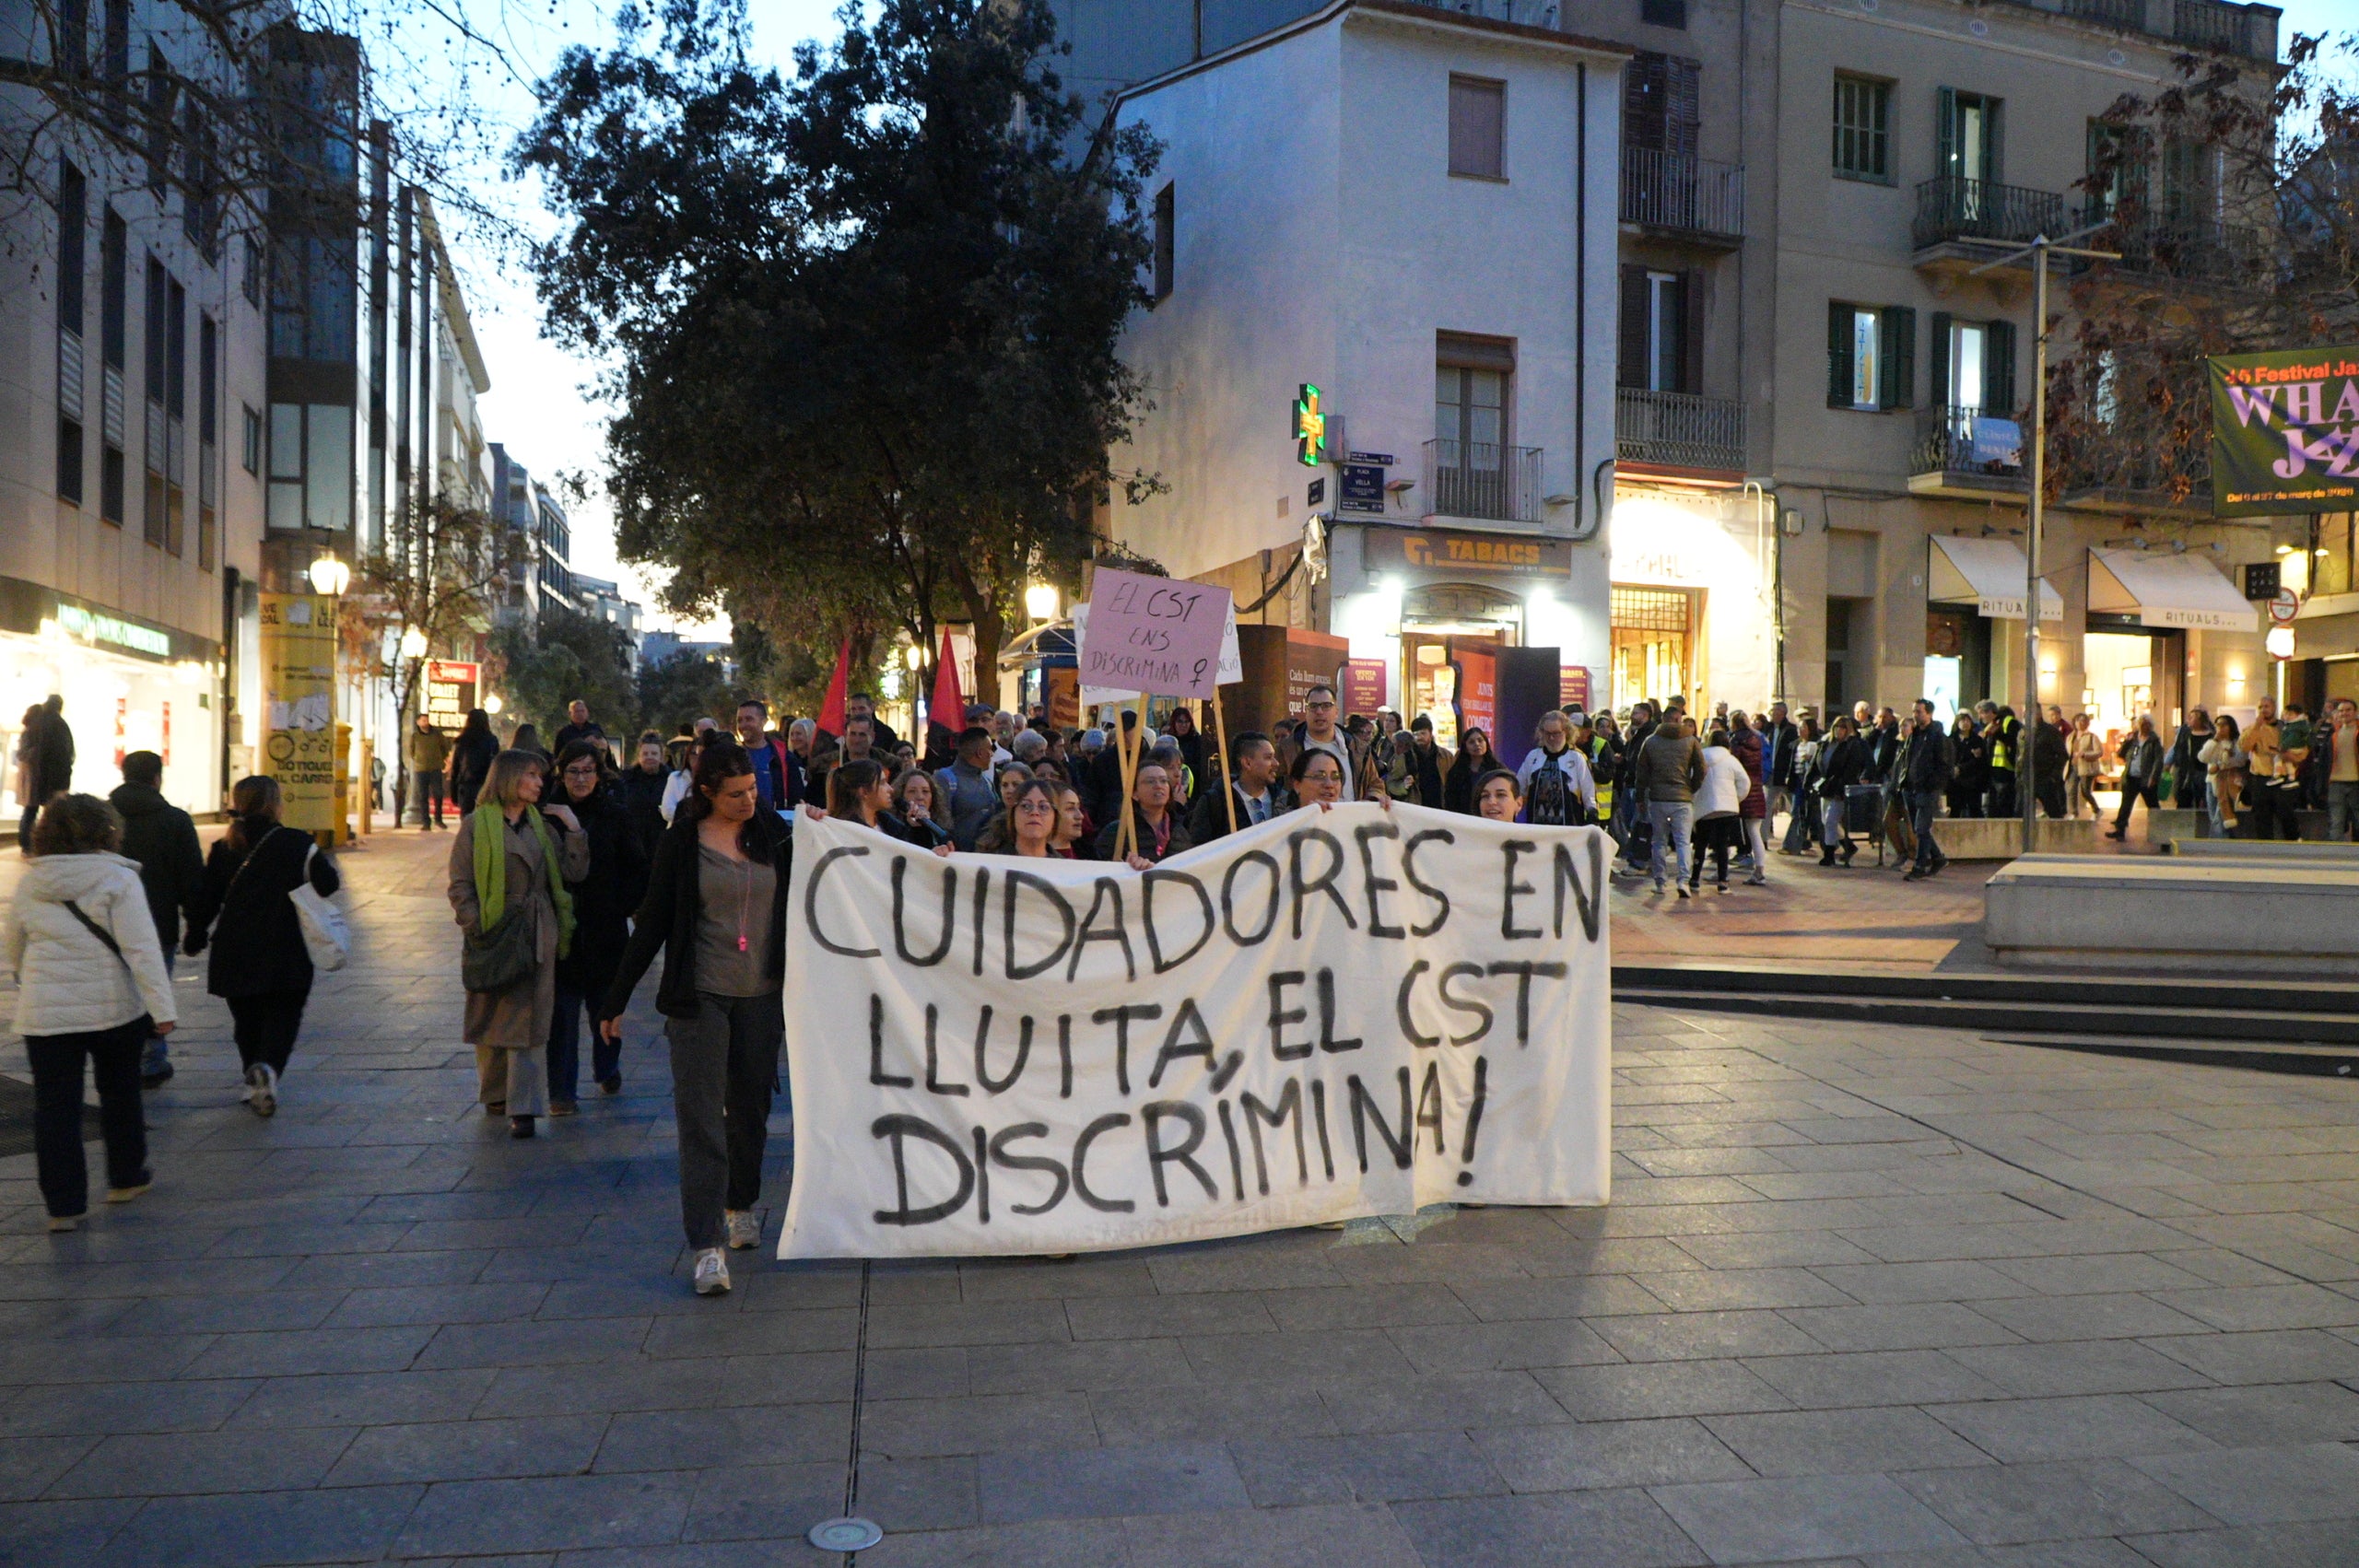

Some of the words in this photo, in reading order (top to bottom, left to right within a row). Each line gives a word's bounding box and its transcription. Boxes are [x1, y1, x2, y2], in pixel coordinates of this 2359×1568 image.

[2255, 362, 2330, 383] Festival
[2332, 359, 2359, 378] Ja
[2226, 493, 2243, 503] Del
[2275, 490, 2287, 500] de
[2313, 489, 2326, 498] de
[1446, 539, 1541, 565] TABACS
[1109, 581, 1139, 614] EL
[1146, 589, 1202, 623] CST
[1982, 600, 2061, 616] RITUA...
[1289, 669, 1303, 683] Cada
[1288, 700, 1301, 716] que
[805, 823, 1454, 984] CUIDADORES
[1500, 825, 1603, 944] EN
[868, 992, 1244, 1098] LLUITA,
[1269, 965, 1363, 1062] EL
[1396, 959, 1567, 1049] CST
[871, 1055, 1489, 1227] DISCRIMINA!
